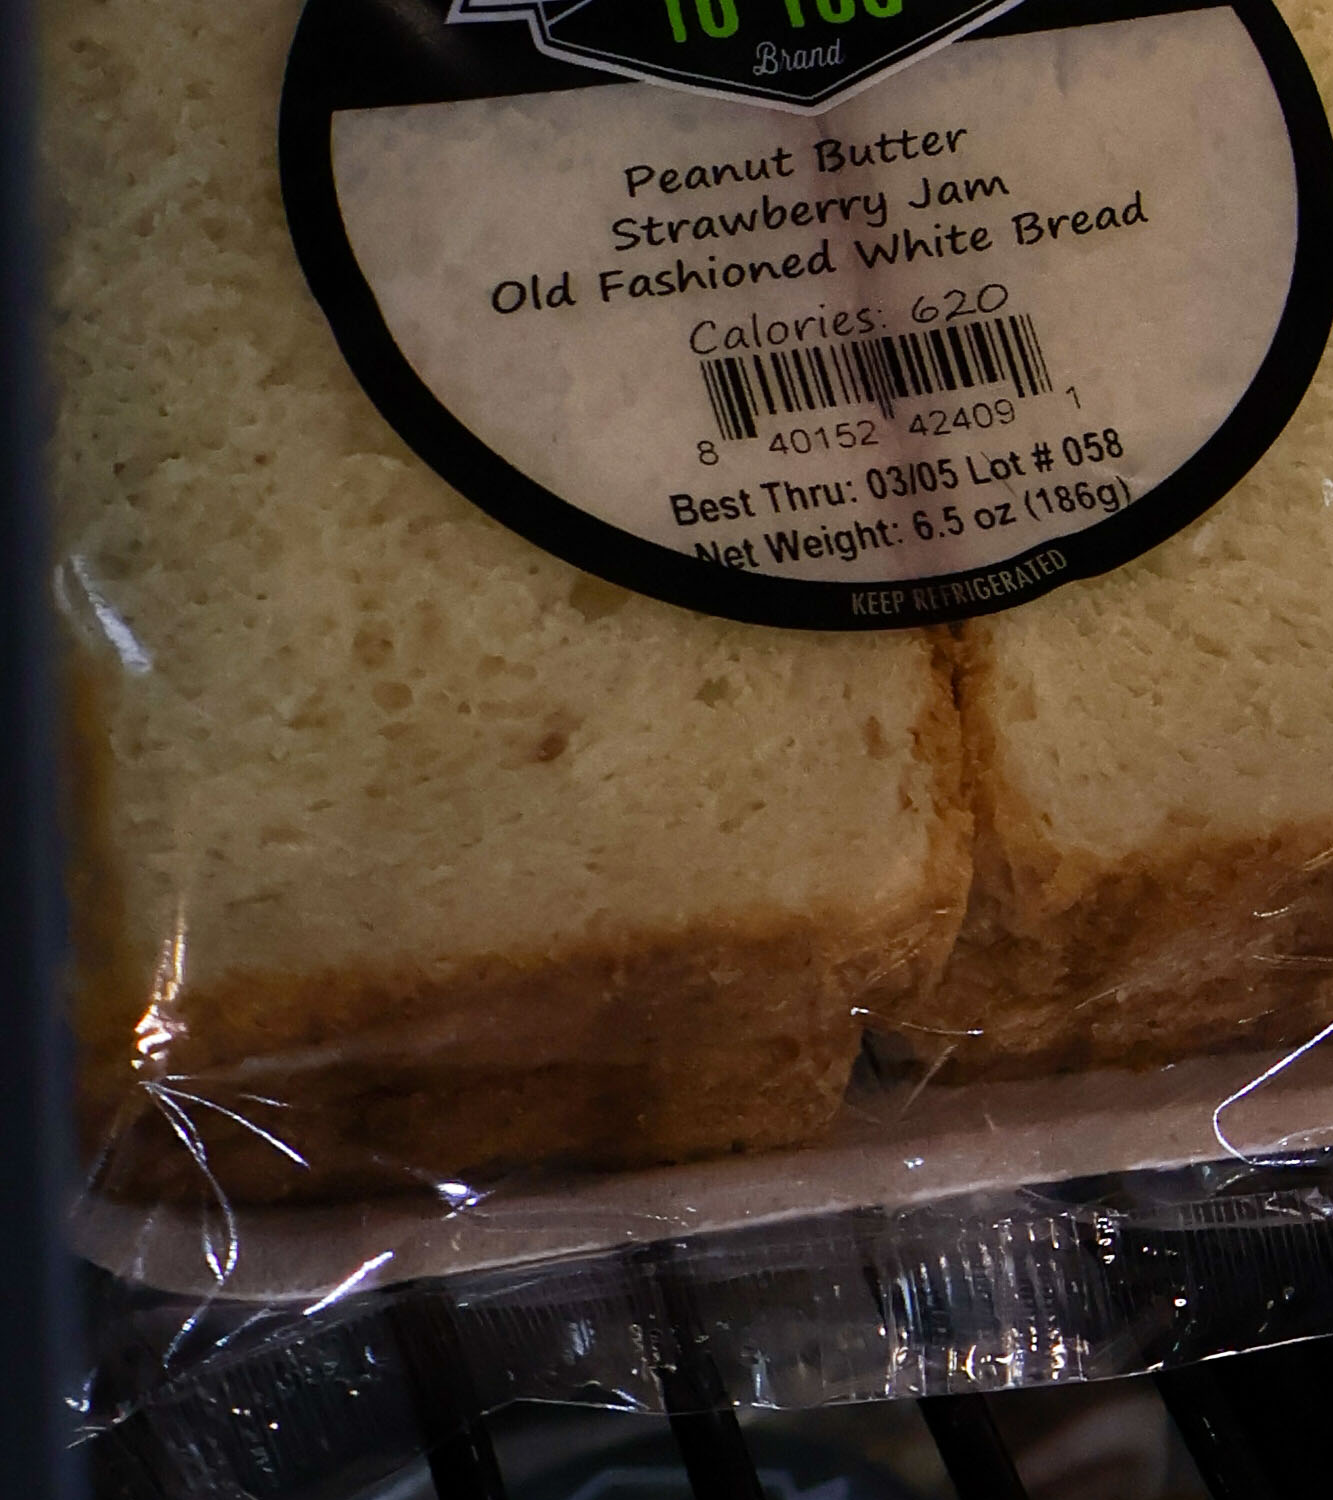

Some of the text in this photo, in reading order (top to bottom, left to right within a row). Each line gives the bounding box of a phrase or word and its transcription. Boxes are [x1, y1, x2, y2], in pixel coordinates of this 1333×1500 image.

[752, 37, 846, 77] Brand
[624, 128, 967, 198] Peanut Butter
[611, 175, 1010, 251] Strawberry Jam
[492, 190, 1149, 314] Old Fashioned White Bread
[690, 284, 1008, 355] Calories: 620
[697, 385, 1081, 466] 8 40152 42409 1
[669, 428, 1124, 526] Best Thru: 03/05 Lot # 058
[694, 475, 1131, 571] Net Weight: 6.5 oz (186g)
[851, 548, 1068, 616] KEEP REFRIGERATED
